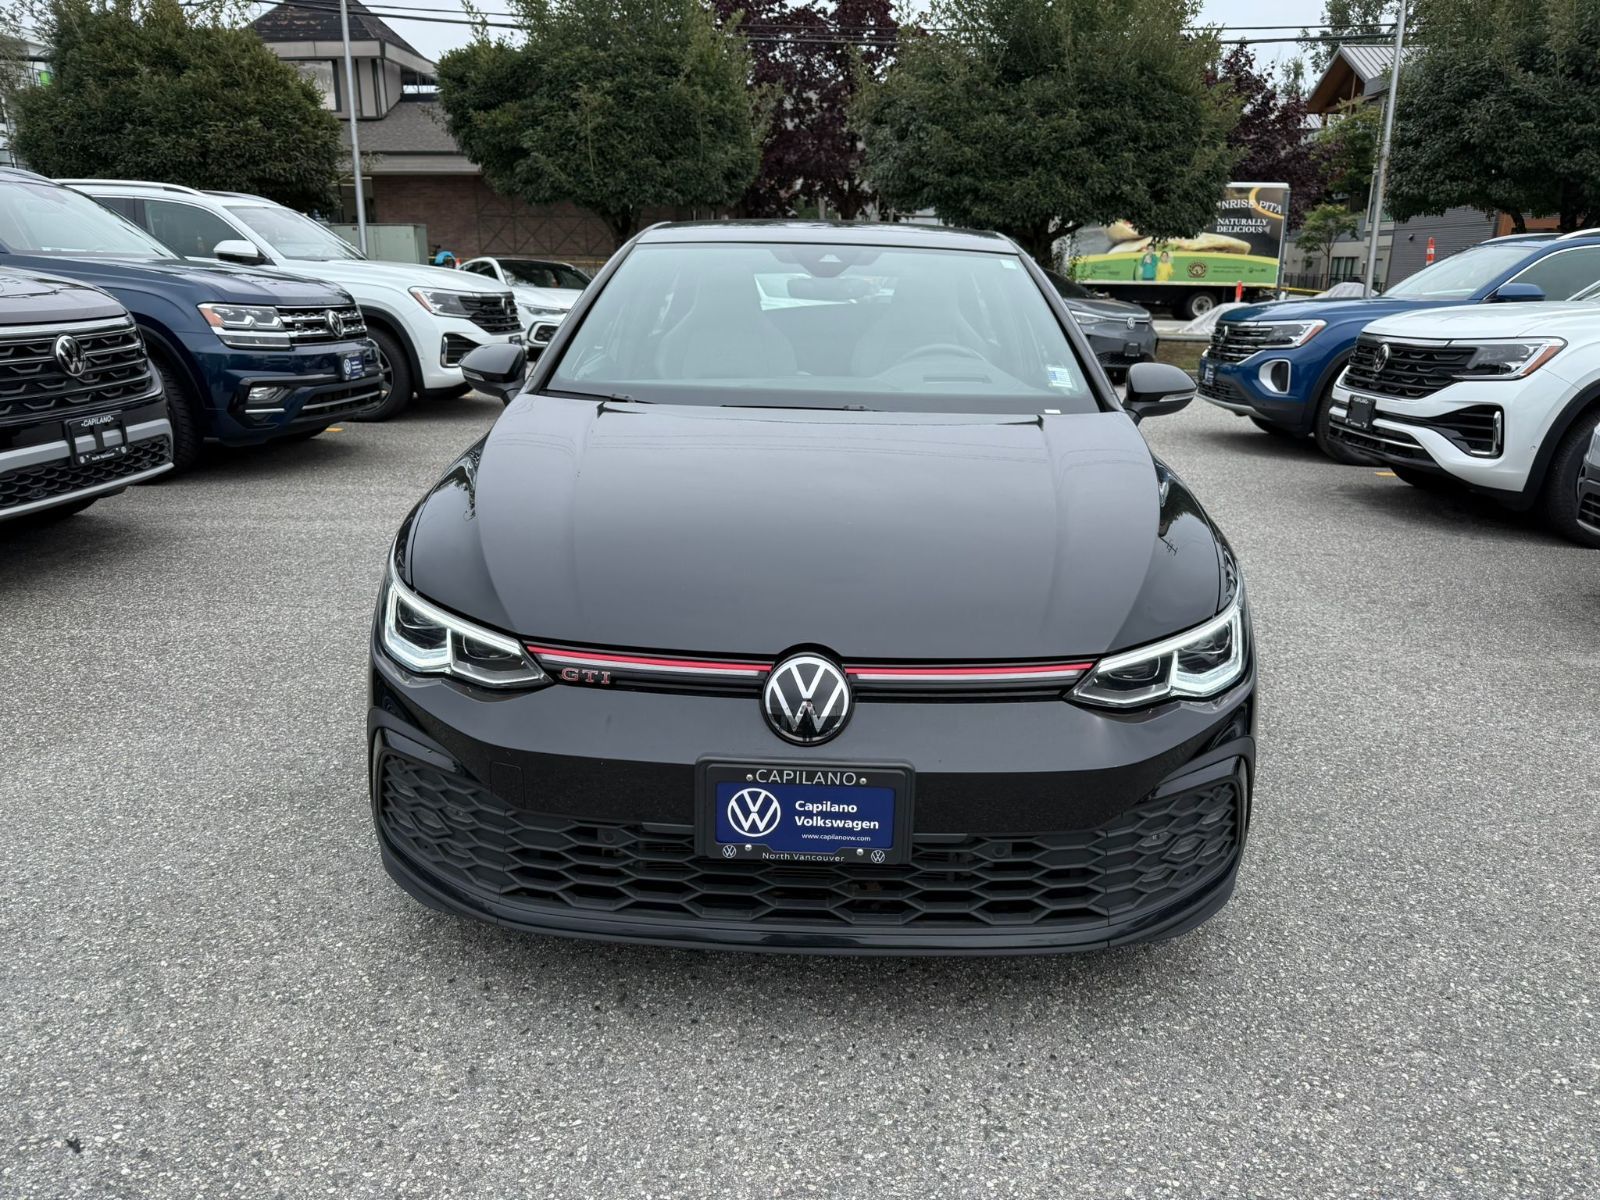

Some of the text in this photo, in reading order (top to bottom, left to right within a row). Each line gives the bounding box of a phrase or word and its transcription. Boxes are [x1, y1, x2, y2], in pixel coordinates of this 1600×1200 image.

[1260, 200, 1282, 214] PITA
[1217, 218, 1268, 226] NATURALLY
[1216, 226, 1263, 234] DELICIOUS
[561, 667, 611, 685] GTI
[755, 769, 857, 786] CAPILANO
[795, 800, 858, 814] Capilano
[795, 815, 879, 831] Volkswagen
[801, 833, 871, 842] www.capilanovw.com
[762, 852, 845, 862] North Vancouver
